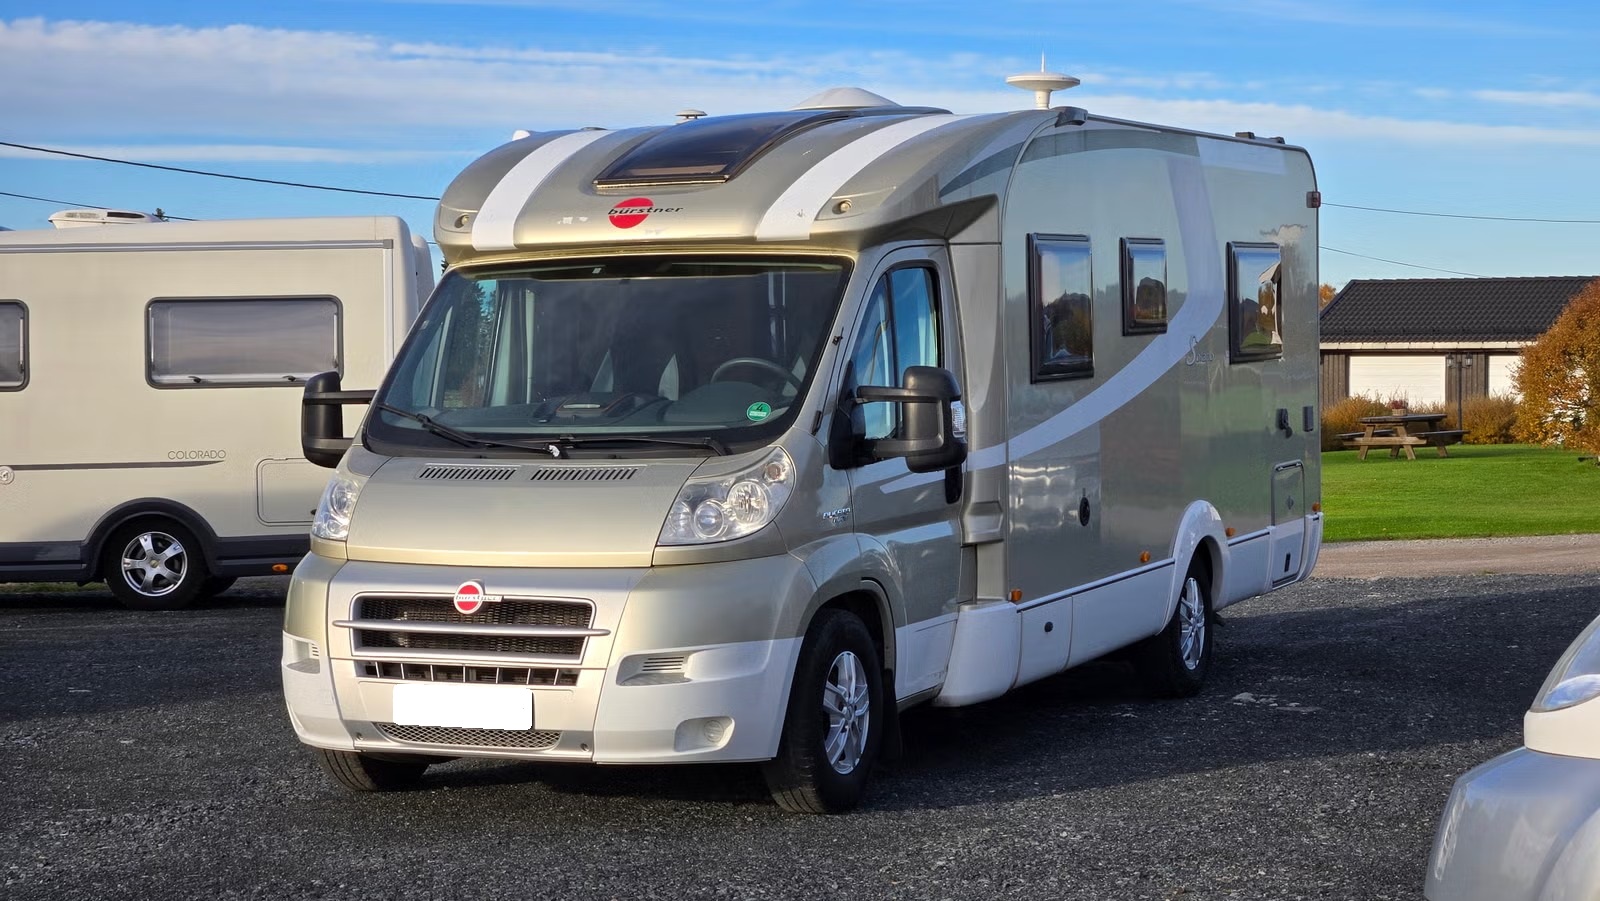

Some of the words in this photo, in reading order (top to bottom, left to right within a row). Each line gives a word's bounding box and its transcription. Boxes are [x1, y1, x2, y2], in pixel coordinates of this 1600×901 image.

[608, 206, 683, 215] bürstner
[756, 403, 763, 412] 4
[168, 449, 227, 460] COLORADO
